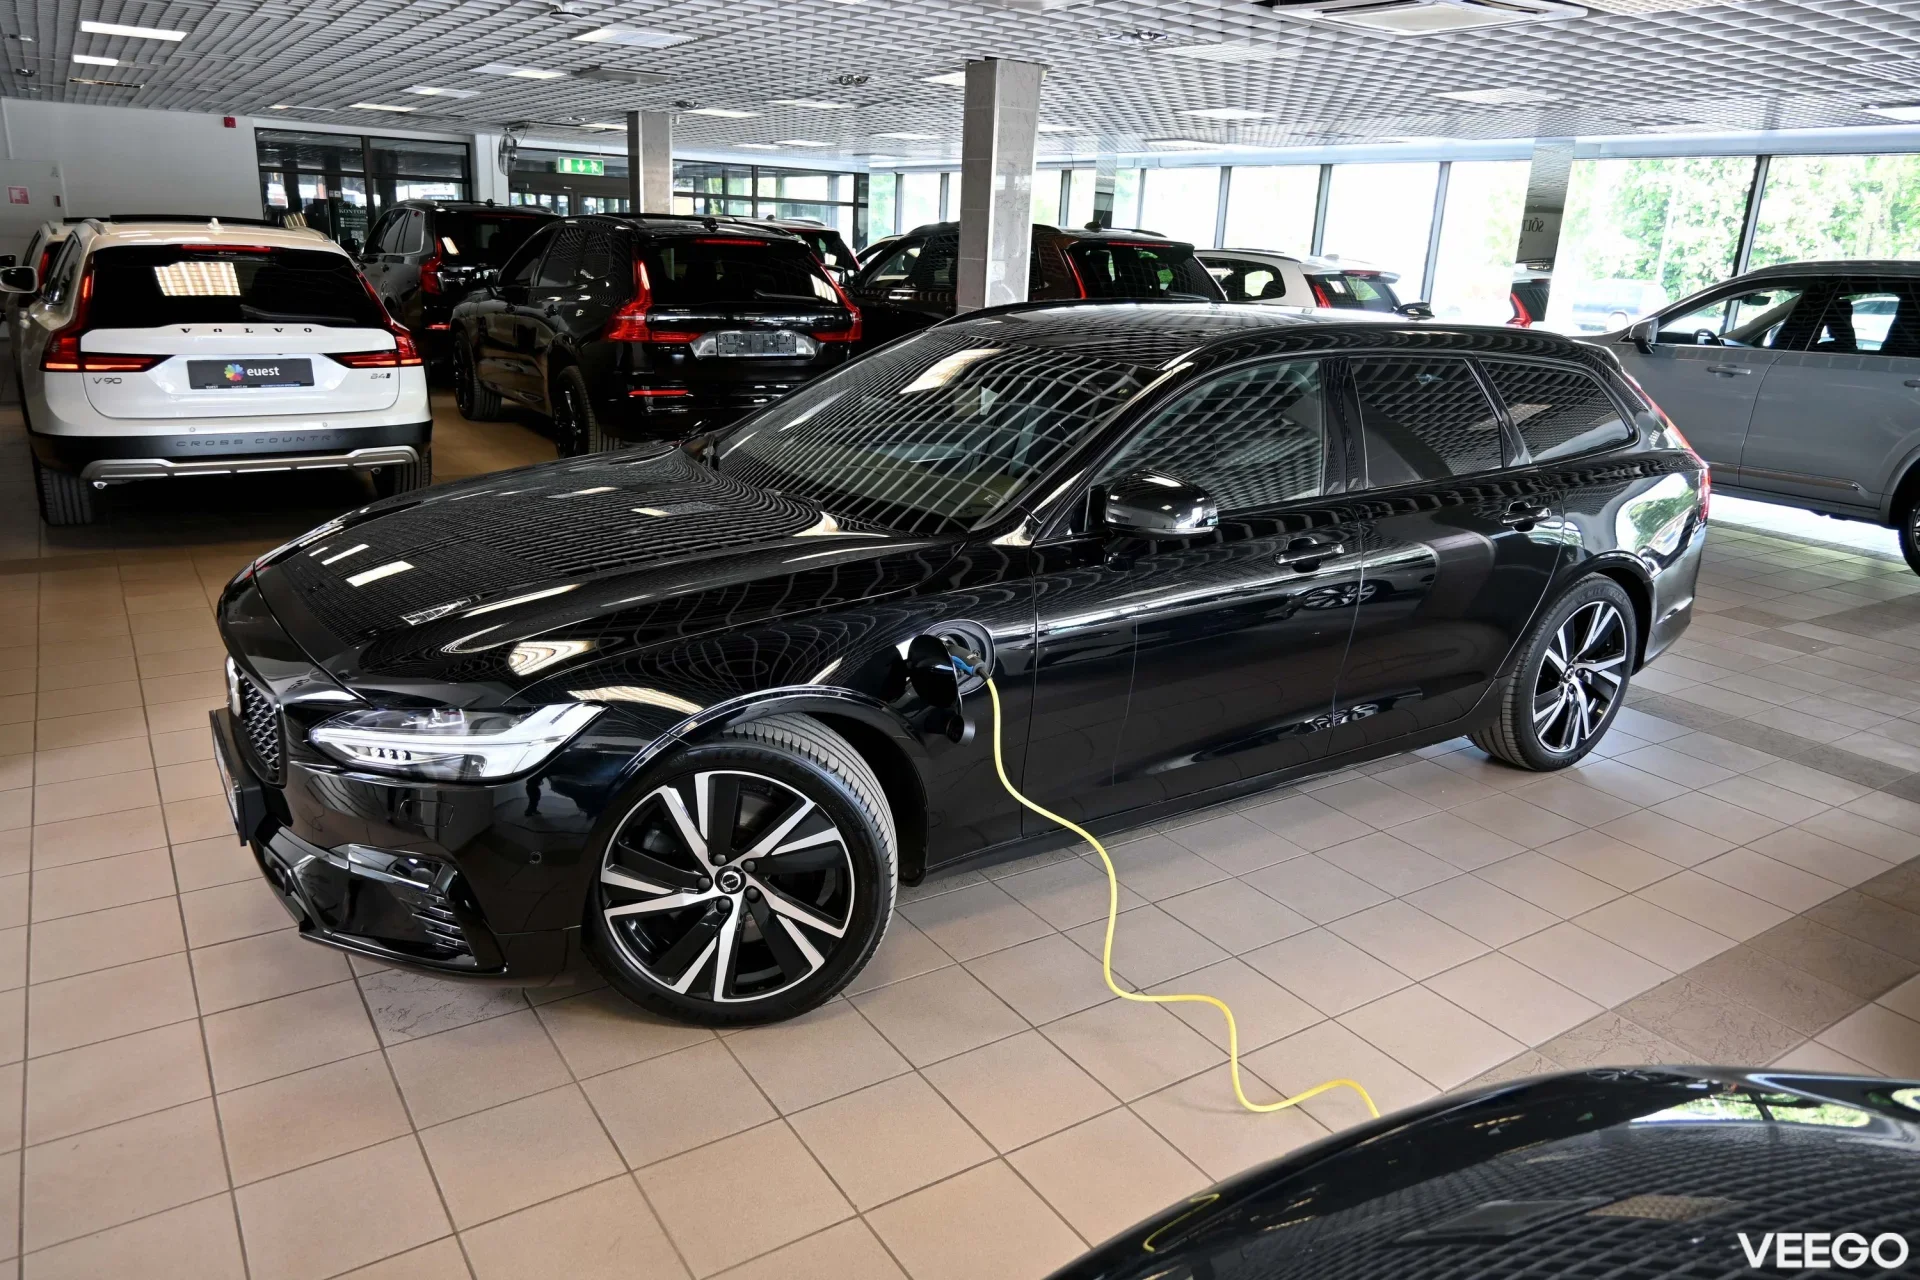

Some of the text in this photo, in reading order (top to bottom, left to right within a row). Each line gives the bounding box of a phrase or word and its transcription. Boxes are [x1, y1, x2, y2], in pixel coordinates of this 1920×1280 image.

[246, 366, 280, 377] euest
[92, 377, 123, 385] V90
[176, 434, 344, 447] CROSS COUNTRY
